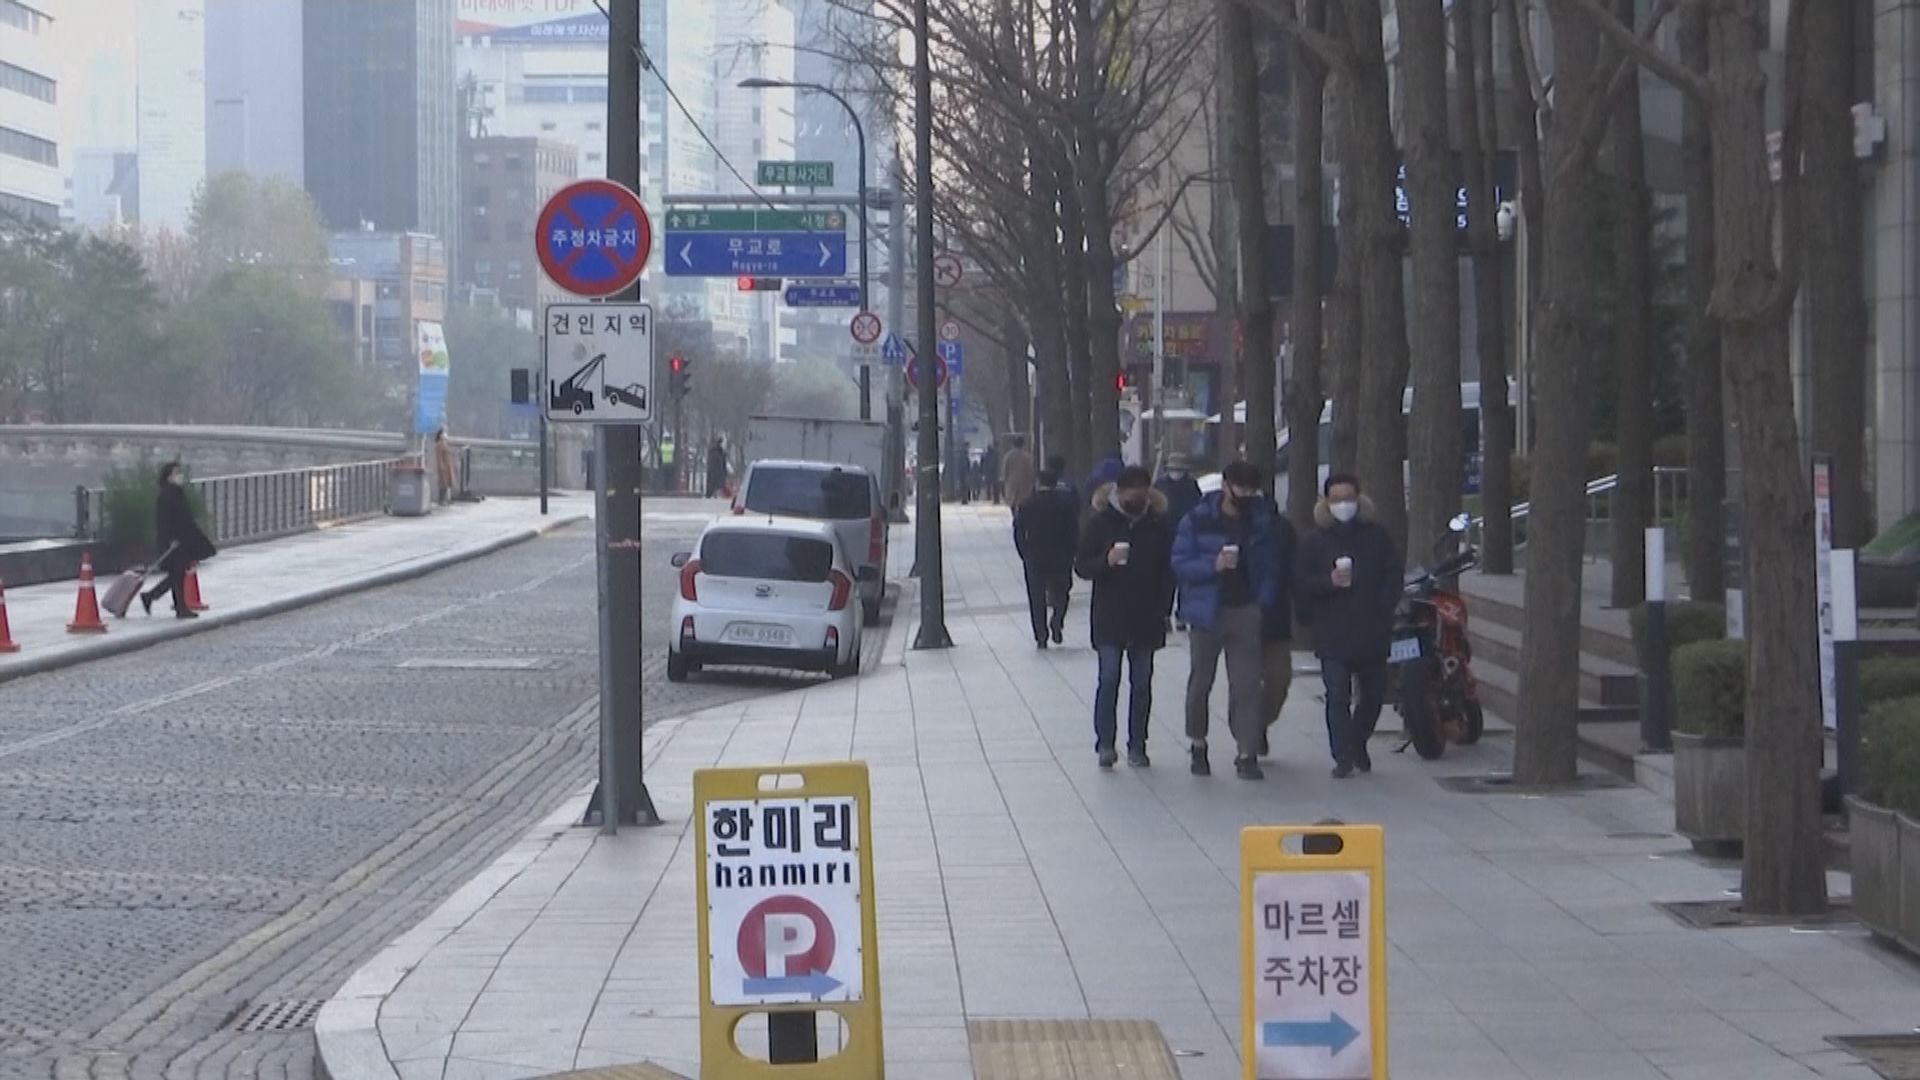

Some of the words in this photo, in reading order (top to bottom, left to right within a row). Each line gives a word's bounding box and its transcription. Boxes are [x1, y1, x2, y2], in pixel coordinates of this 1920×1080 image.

[801, 214, 825, 228] 시청
[552, 228, 637, 248] 주정차금지
[727, 238, 784, 256] 무교로
[552, 314, 646, 335] 견인지역
[712, 803, 854, 857] 한미리
[714, 862, 851, 888] hanmiri
[1263, 899, 1361, 940] 마르셀
[765, 913, 817, 979] P
[1263, 955, 1362, 997] 주차장
